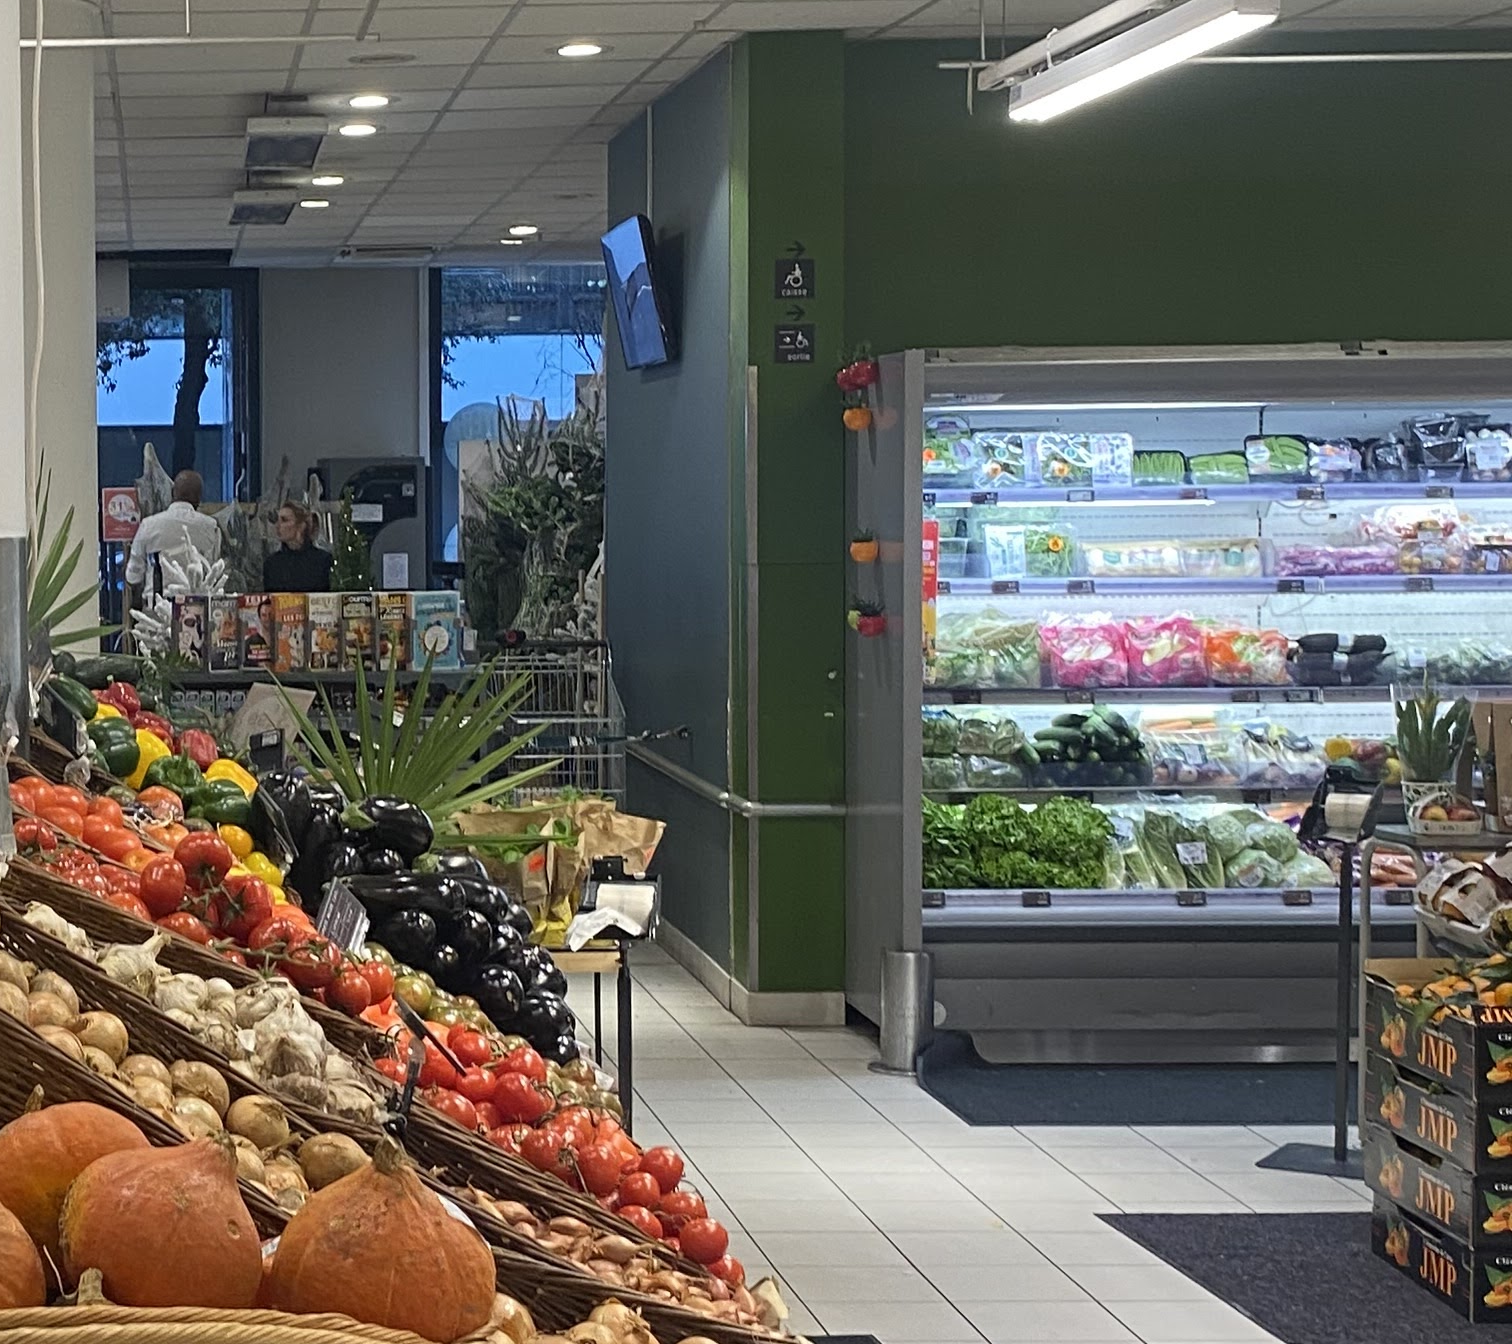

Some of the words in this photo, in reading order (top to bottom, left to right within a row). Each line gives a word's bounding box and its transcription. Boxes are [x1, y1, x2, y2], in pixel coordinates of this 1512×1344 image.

[781, 288, 808, 296] caisse
[1417, 1031, 1458, 1079] JMP
[1417, 1105, 1458, 1153] JMP
[1415, 1174, 1455, 1226] JMP
[1419, 1246, 1457, 1297] JMP
